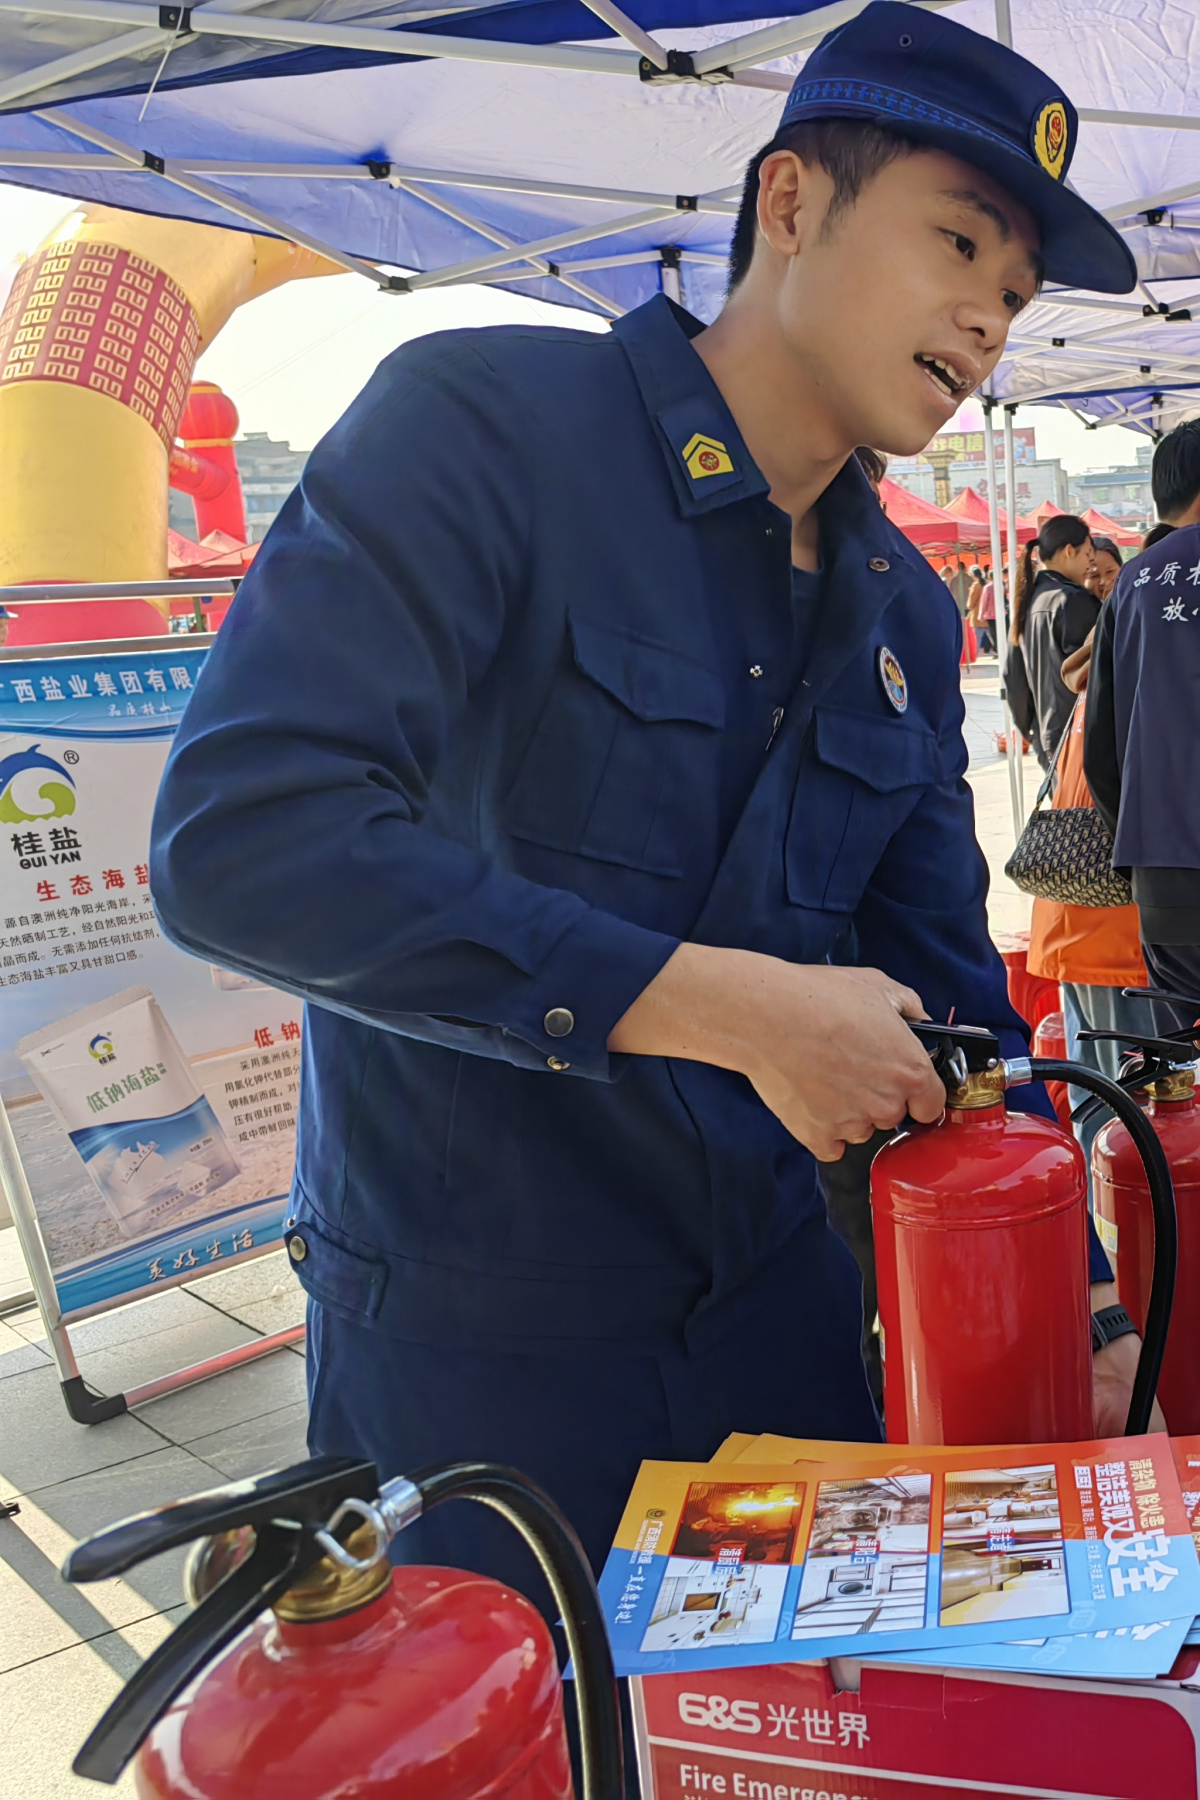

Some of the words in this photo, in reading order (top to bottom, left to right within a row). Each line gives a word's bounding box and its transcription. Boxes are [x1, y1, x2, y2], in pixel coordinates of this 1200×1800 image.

[0, 666, 201, 703] 西盐业集团有限
[11, 827, 82, 858] 桂盐
[20, 855, 47, 869] GUI
[50, 851, 82, 864] YAN
[36, 864, 149, 901] 生态海盐
[0, 928, 160, 968] 晶而成。无需添加任何抗结剂，
[254, 1020, 301, 1048] 低钠
[86, 1065, 161, 1113] 低钠海盐
[228, 1082, 300, 1110] 钾精制而成，对
[146, 1228, 255, 1281] 美好生活
[1129, 1458, 1157, 1491] 清杂物
[1095, 1461, 1178, 1598] 整洁美观又安全
[1135, 1493, 1165, 1529] 除火患
[767, 1703, 871, 1749] 光世界
[680, 1763, 727, 1794] Fire
[733, 1772, 868, 1800] Emerge
